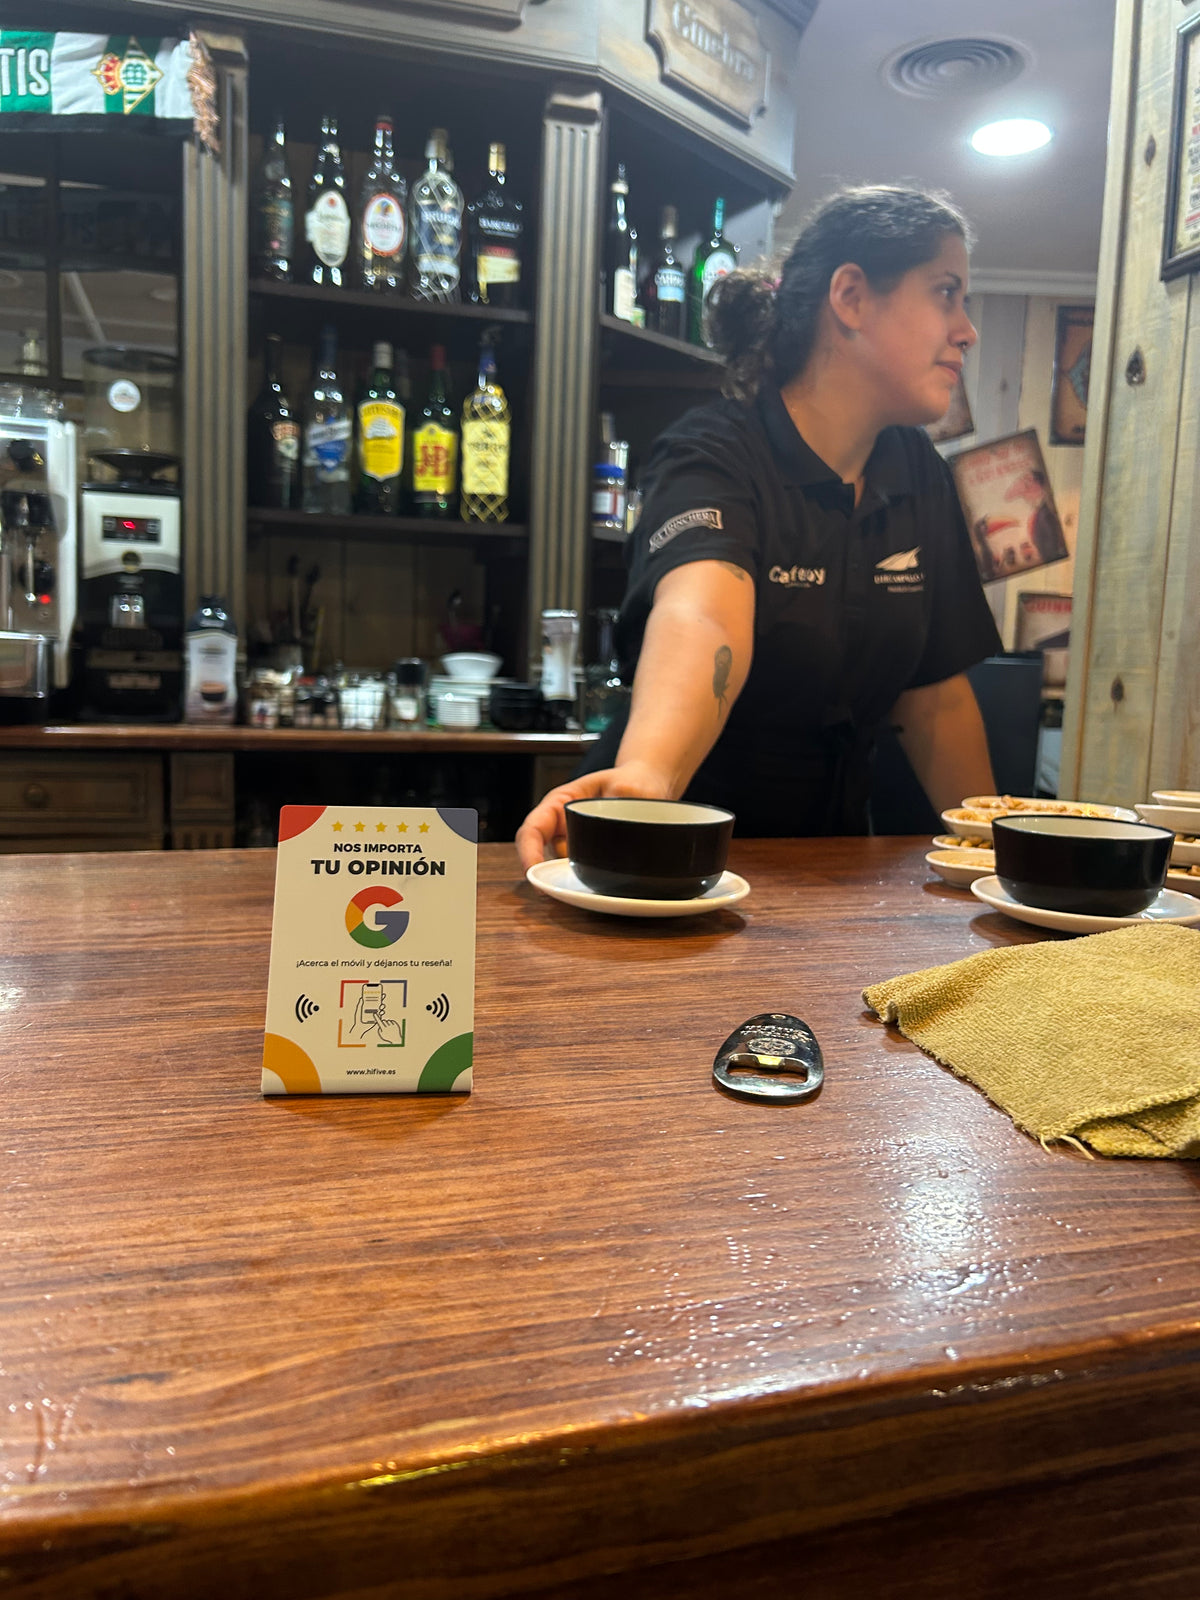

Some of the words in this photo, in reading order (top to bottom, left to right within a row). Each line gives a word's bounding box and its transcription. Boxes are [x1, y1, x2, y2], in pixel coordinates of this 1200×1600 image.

[334, 843, 362, 853] NOS
[364, 843, 423, 854] IMPORTA
[310, 859, 341, 875] TU
[347, 856, 446, 876] OPINIÓN
[295, 959, 329, 969] ¡Acerca
[331, 959, 339, 967] el
[341, 959, 365, 967] móvil
[366, 961, 372, 969] y
[374, 959, 408, 969] déjanos
[421, 959, 453, 967] reseña!
